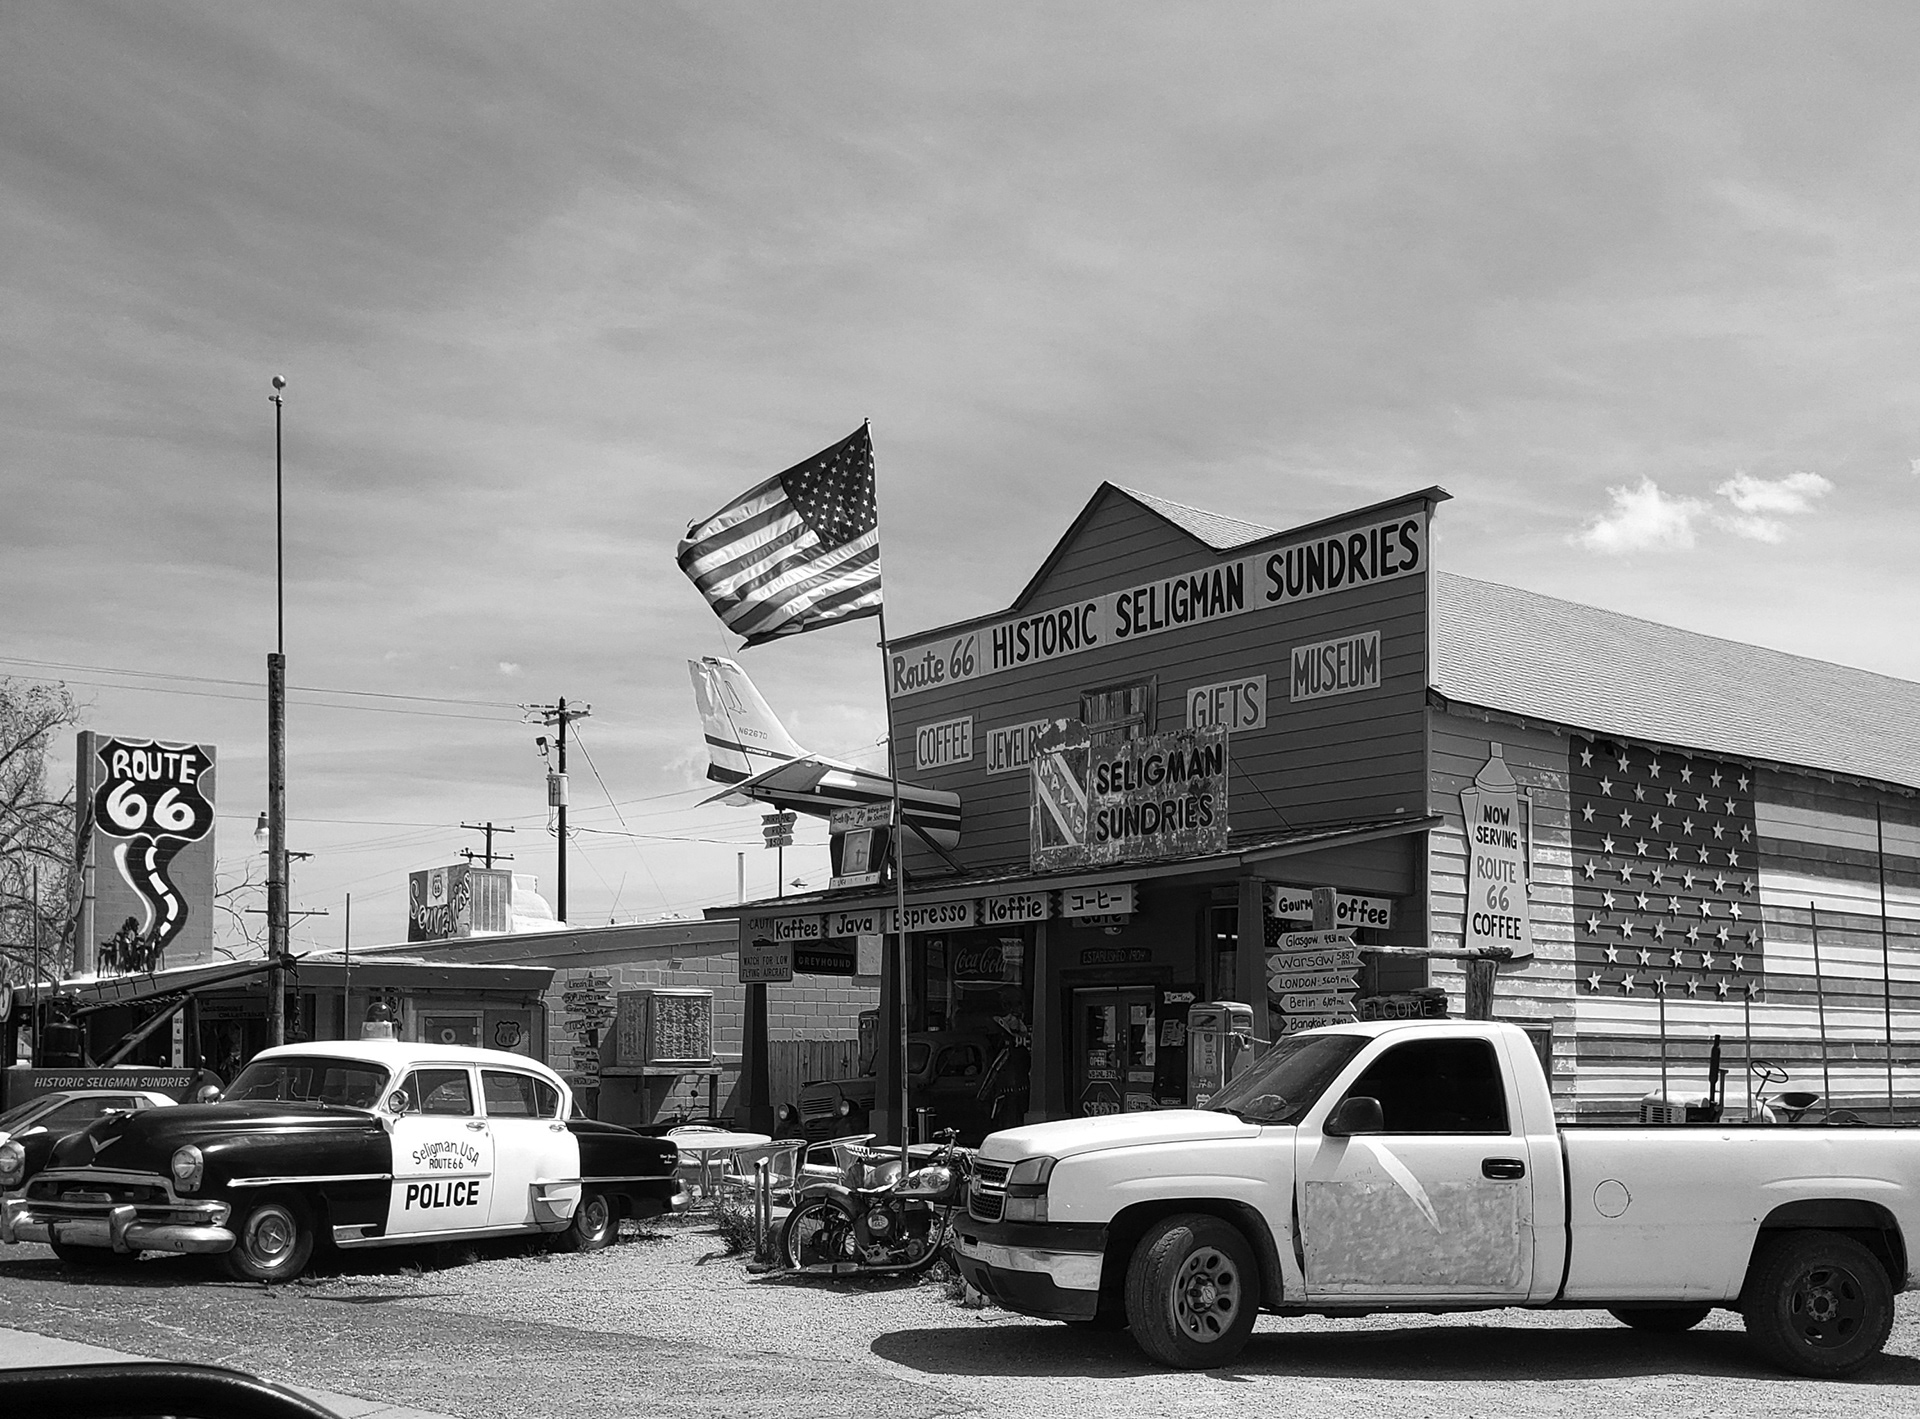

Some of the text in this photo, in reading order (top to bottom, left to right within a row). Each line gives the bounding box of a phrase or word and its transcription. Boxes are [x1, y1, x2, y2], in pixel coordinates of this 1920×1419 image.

[893, 520, 1419, 693] Route 66 HISTORIC SELIGMAN SUNDRIES
[1293, 635, 1378, 698] MUSEUM
[1191, 682, 1260, 729] GIFTS
[918, 720, 971, 766] COFFEE
[988, 723, 1047, 770] JEWELR
[113, 749, 196, 784] ROUTE
[1096, 743, 1222, 795] SELIGMAN
[106, 780, 195, 831] 66
[1040, 759, 1084, 834] MALTS
[1096, 795, 1214, 842] SUNDRIES
[1484, 804, 1510, 825] NOW
[1476, 826, 1518, 850] SERVING
[1477, 855, 1516, 884] ROUTE
[989, 894, 1043, 921] Koffie
[1071, 890, 1123, 911] コーヒー
[1337, 898, 1388, 925] offee
[1486, 885, 1510, 911] 66
[775, 919, 818, 940] Kaffee
[837, 914, 873, 934] Java
[893, 902, 967, 931] Espresso
[1473, 912, 1521, 941] COFFEE
[762, 956, 773, 965] FOR
[798, 955, 851, 968] GREYHOUND
[1278, 955, 1334, 969] Warsaw
[1291, 1017, 1327, 1030] Bangkok
[1359, 1000, 1433, 1020] ELCOME
[500, 1032, 515, 1043] 66
[34, 1077, 190, 1087] HISTORIC SELIGMAN SUNDRIES
[460, 1141, 480, 1167] USA
[405, 1181, 480, 1210] POLICE
